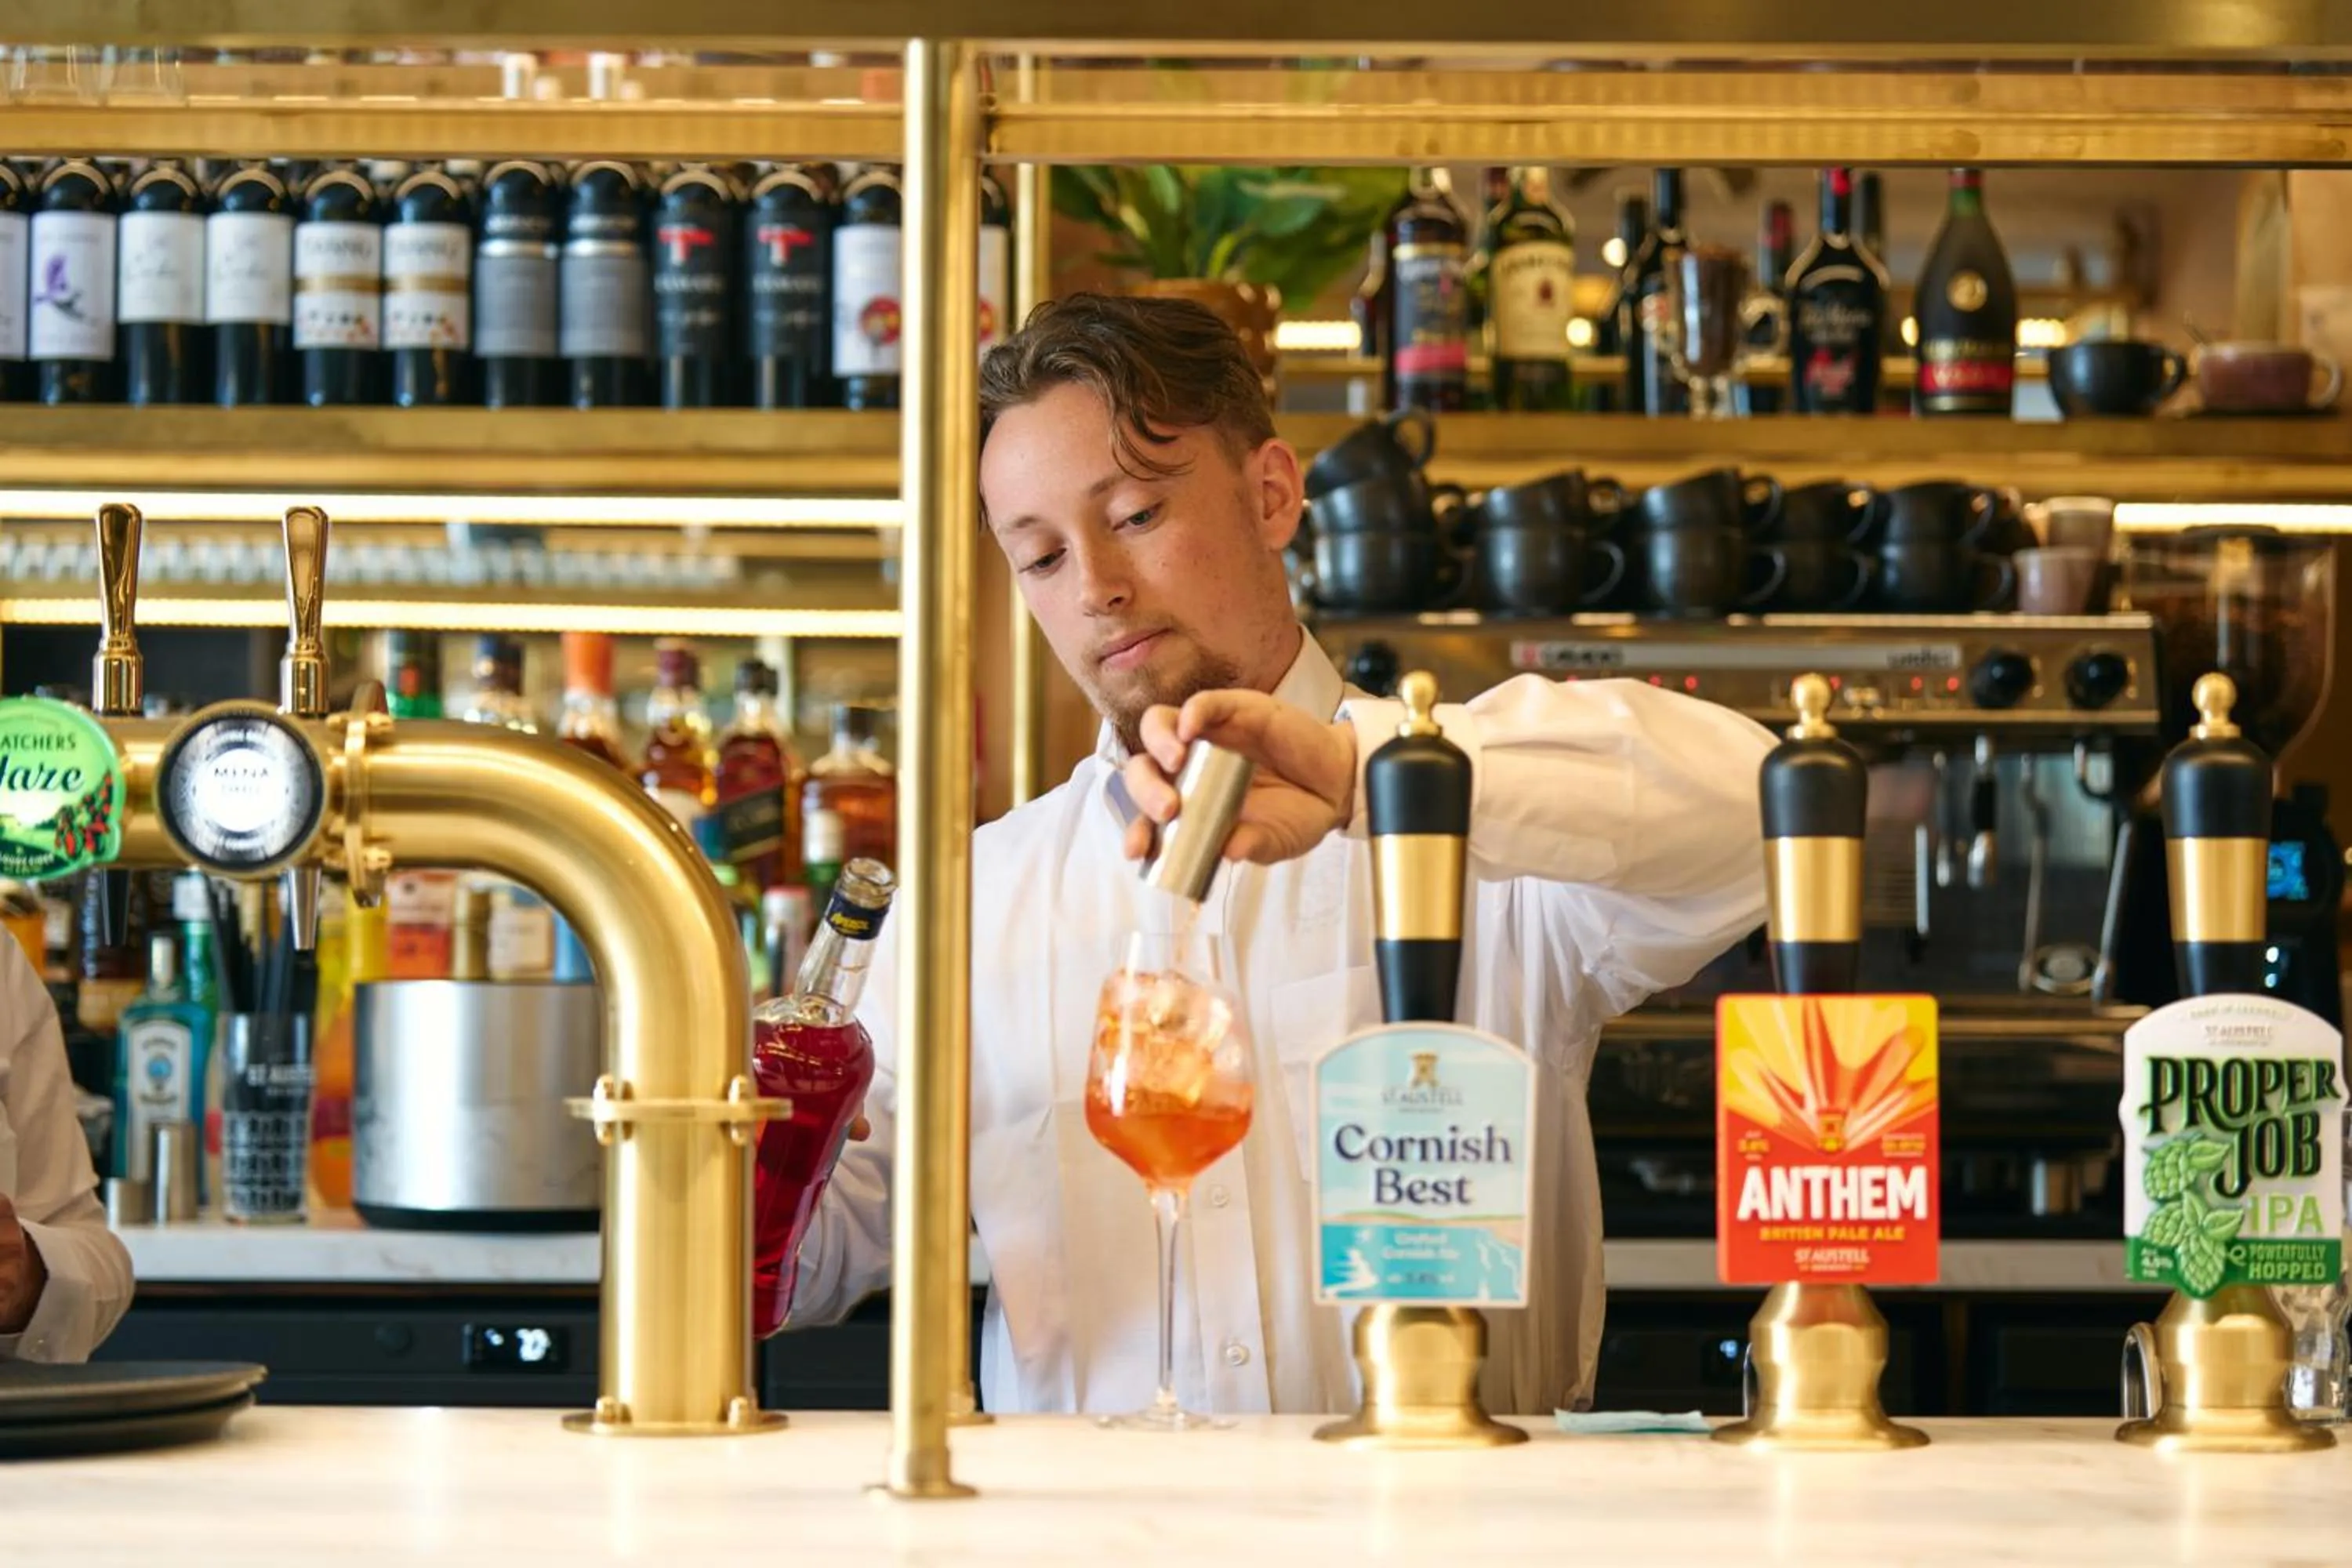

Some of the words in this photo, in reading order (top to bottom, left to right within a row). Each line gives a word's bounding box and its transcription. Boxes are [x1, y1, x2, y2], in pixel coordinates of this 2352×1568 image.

[0, 734, 76, 750] ATCHERS
[2138, 1056, 2341, 1135] PROPER
[1334, 1124, 1512, 1163] Cornish
[2212, 1110, 2321, 1198] JOB
[1374, 1168, 1472, 1205] Best
[1737, 1165, 1928, 1221] ANTHEM
[1760, 1226, 1824, 1241] BRITISH
[1828, 1226, 1868, 1241] PALE
[1873, 1226, 1906, 1241] ALE
[2248, 1196, 2325, 1234] IPA
[2249, 1244, 2326, 1261] POWERFULLY
[2249, 1261, 2326, 1280] HOPPED
